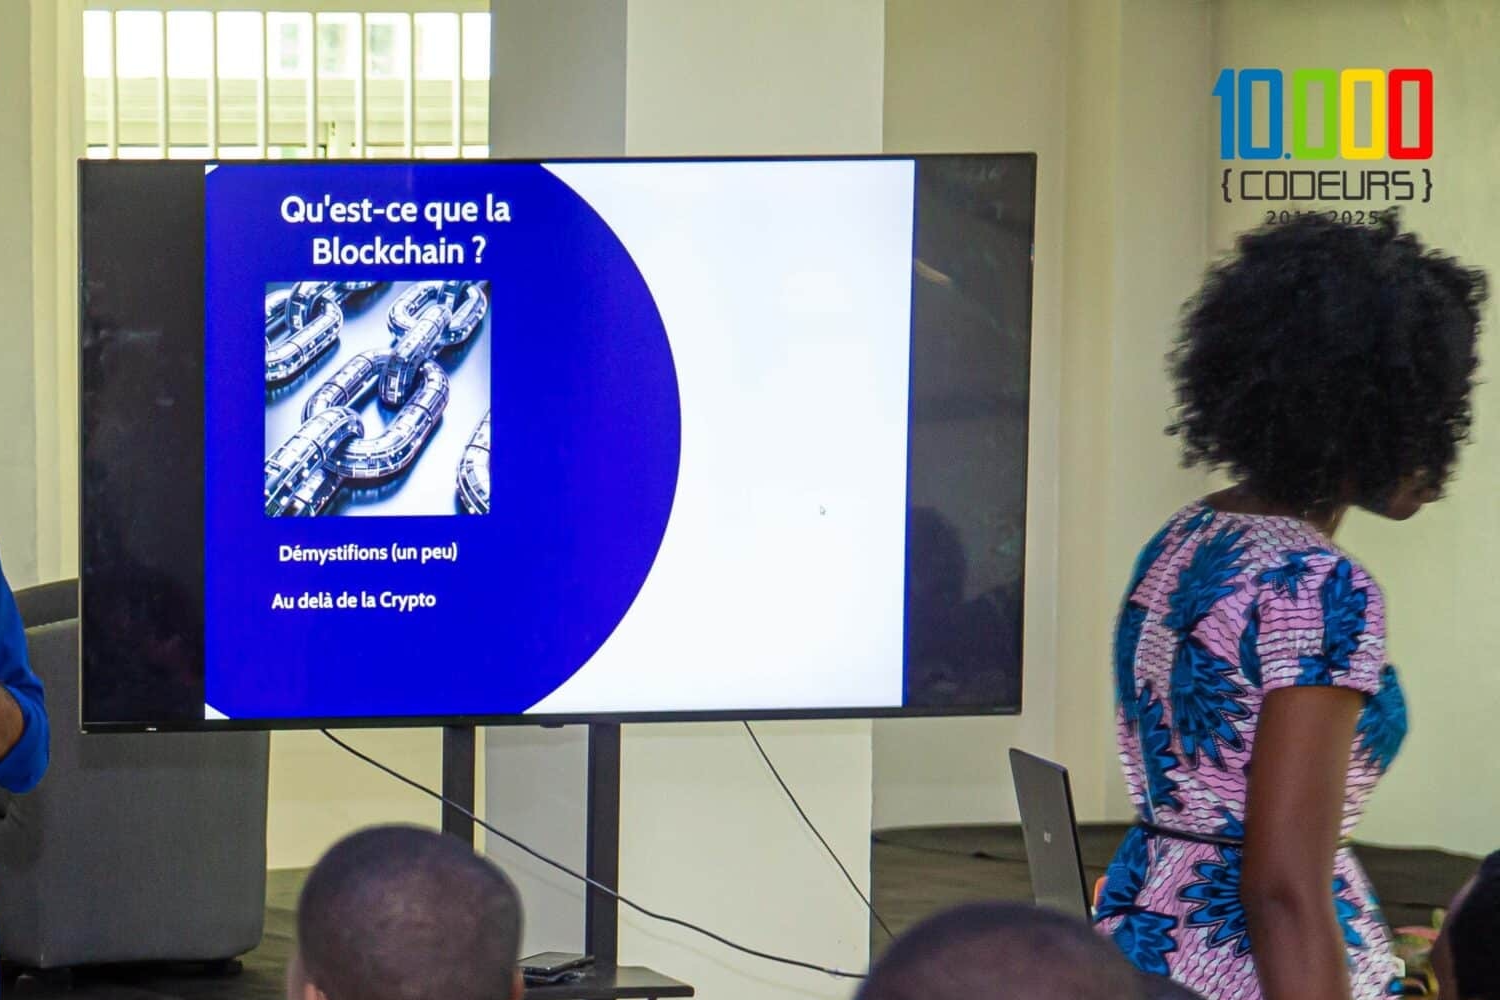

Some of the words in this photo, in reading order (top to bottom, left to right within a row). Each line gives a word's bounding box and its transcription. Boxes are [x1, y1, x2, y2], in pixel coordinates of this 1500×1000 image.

[280, 194, 418, 223] Qu'est-ce
[424, 201, 479, 231] que
[486, 193, 511, 222] la
[312, 236, 464, 265] Blockchain
[472, 235, 487, 264] ?
[279, 543, 389, 566] Démystifions
[391, 543, 418, 563] (un
[421, 542, 458, 564] peu)
[271, 593, 295, 610] Au
[297, 592, 334, 609] delà
[336, 592, 358, 608] de
[361, 591, 377, 608] la
[379, 591, 437, 612] Crypto
